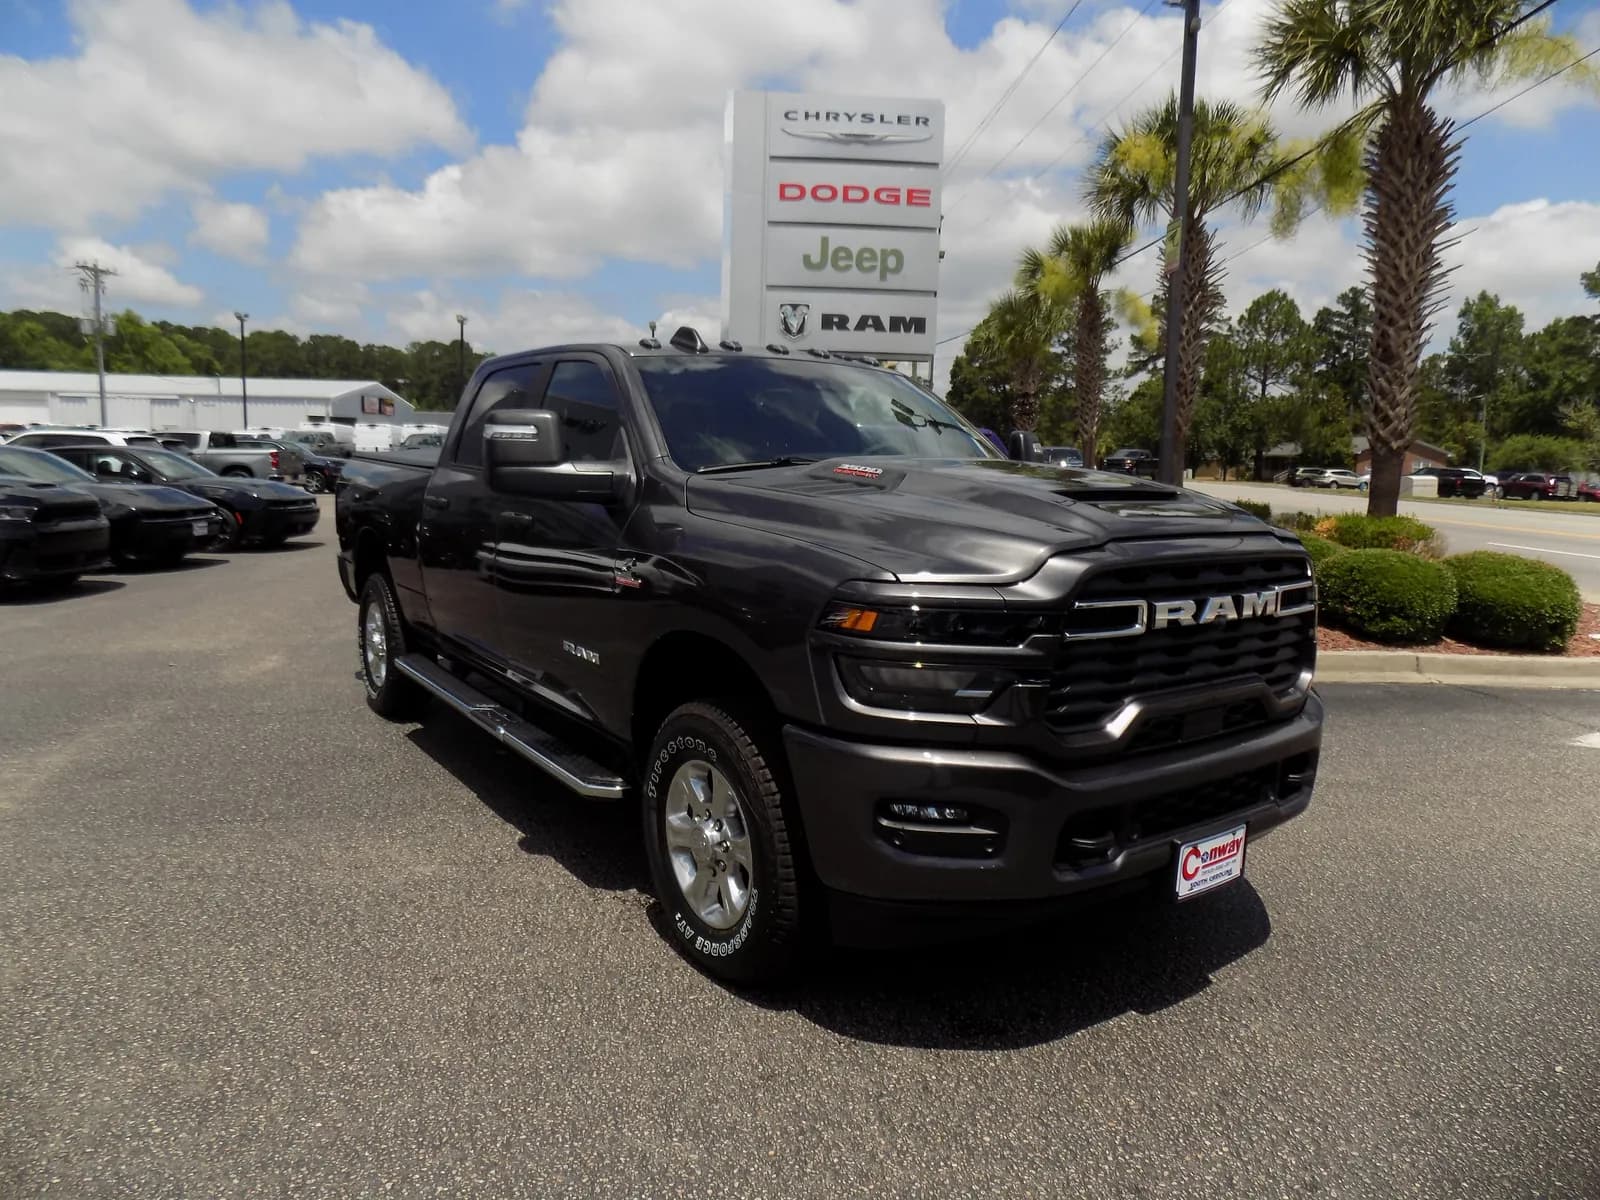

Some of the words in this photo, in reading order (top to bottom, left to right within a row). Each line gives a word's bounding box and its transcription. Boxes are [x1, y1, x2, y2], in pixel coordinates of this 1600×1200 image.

[783, 110, 930, 127] CHRYSLER
[778, 183, 931, 207] DODGE
[802, 236, 905, 282] Jeep
[820, 313, 927, 335] RAM
[1151, 590, 1277, 630] RAM
[562, 640, 600, 665] RAM
[647, 735, 718, 799] Firestone
[1182, 838, 1243, 881] Conway
